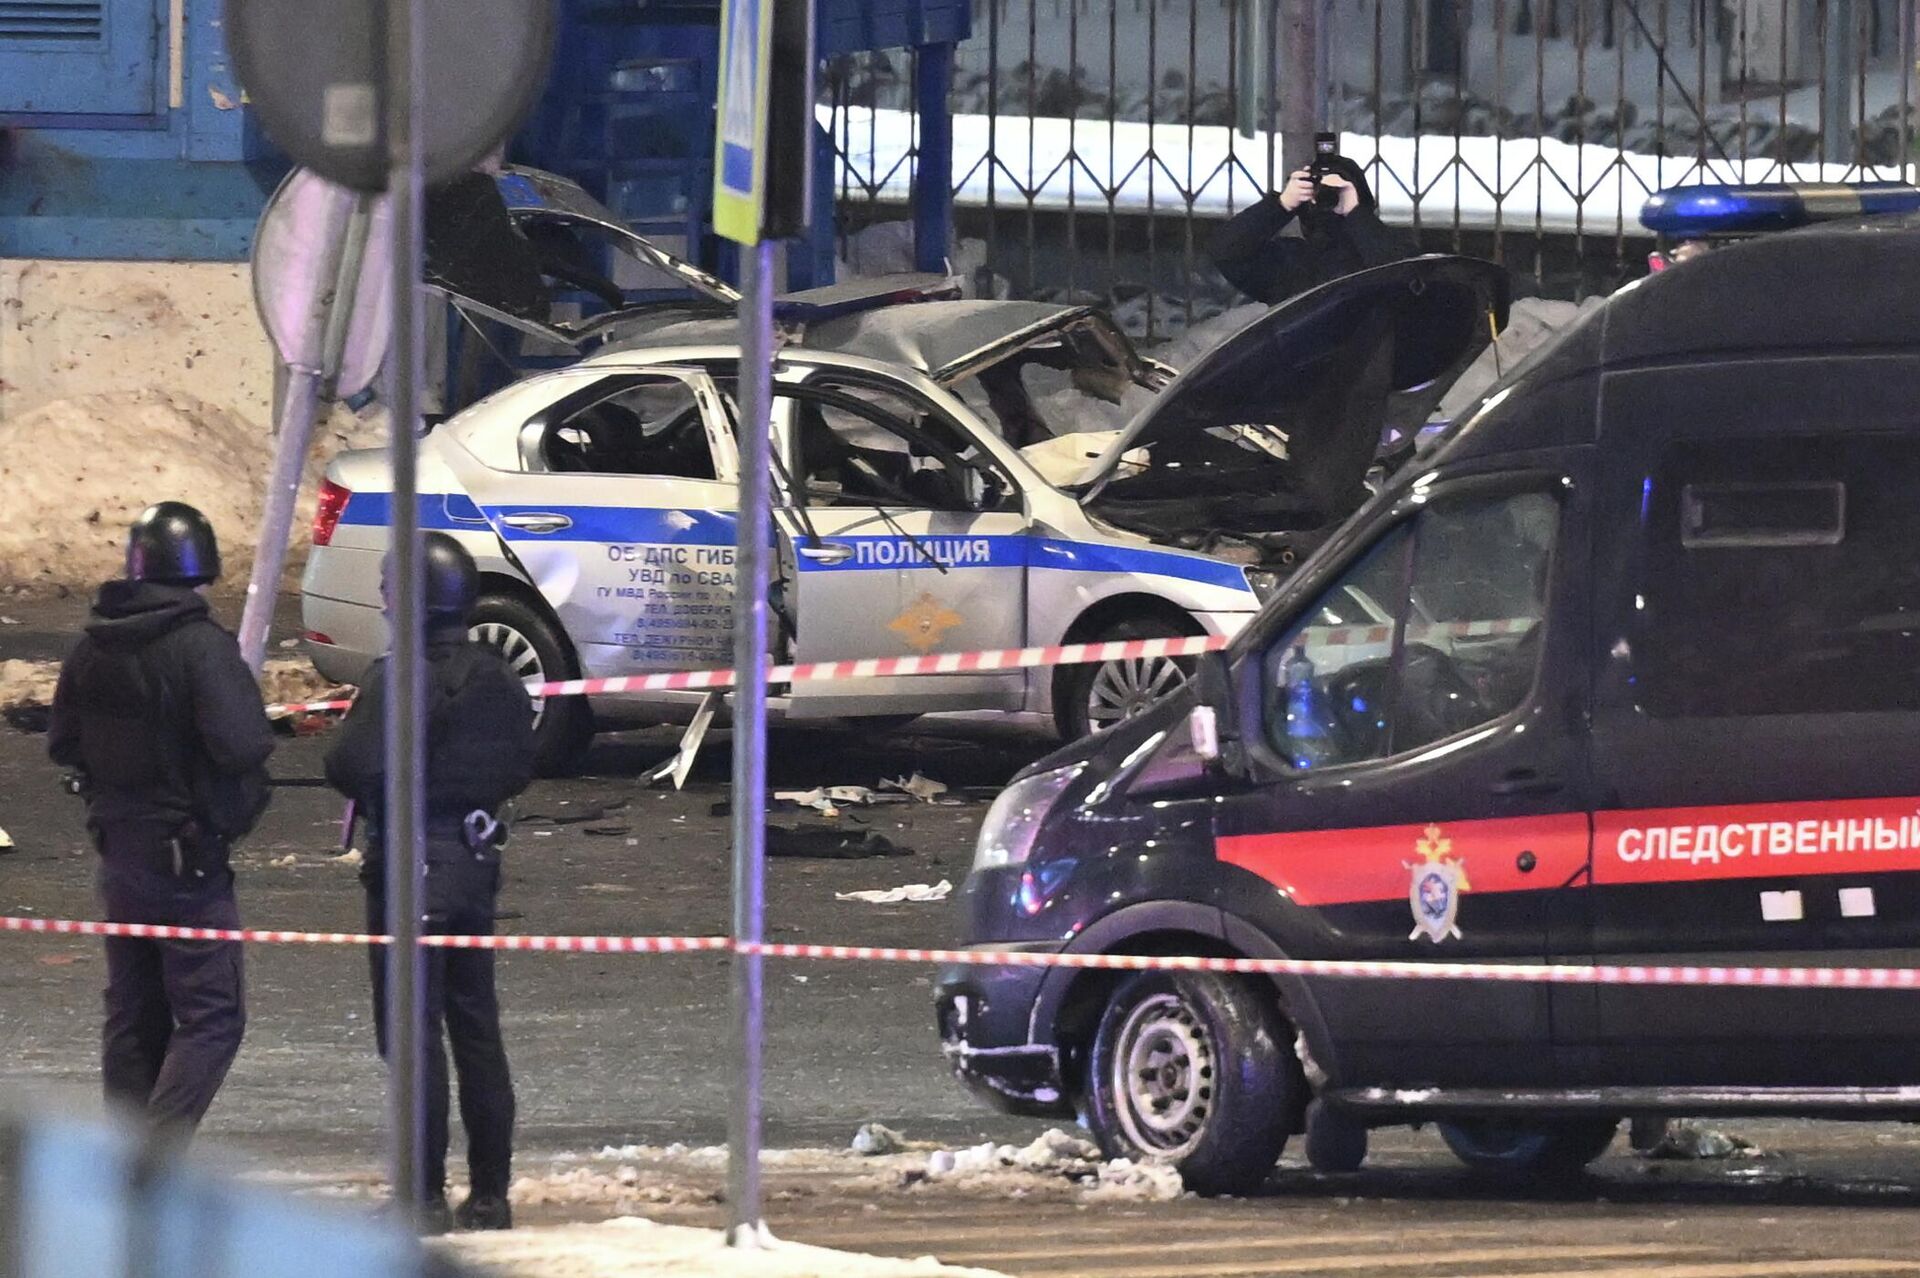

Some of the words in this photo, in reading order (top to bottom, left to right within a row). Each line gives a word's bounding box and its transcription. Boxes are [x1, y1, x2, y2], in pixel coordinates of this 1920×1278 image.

[644, 547, 688, 566] ДПС
[696, 548, 735, 565] ГИБ
[855, 539, 991, 567] ПОЛИЦИЯ
[629, 568, 664, 585] УВД
[671, 573, 692, 584] по
[697, 571, 735, 586] СВА
[616, 588, 645, 598] МВД
